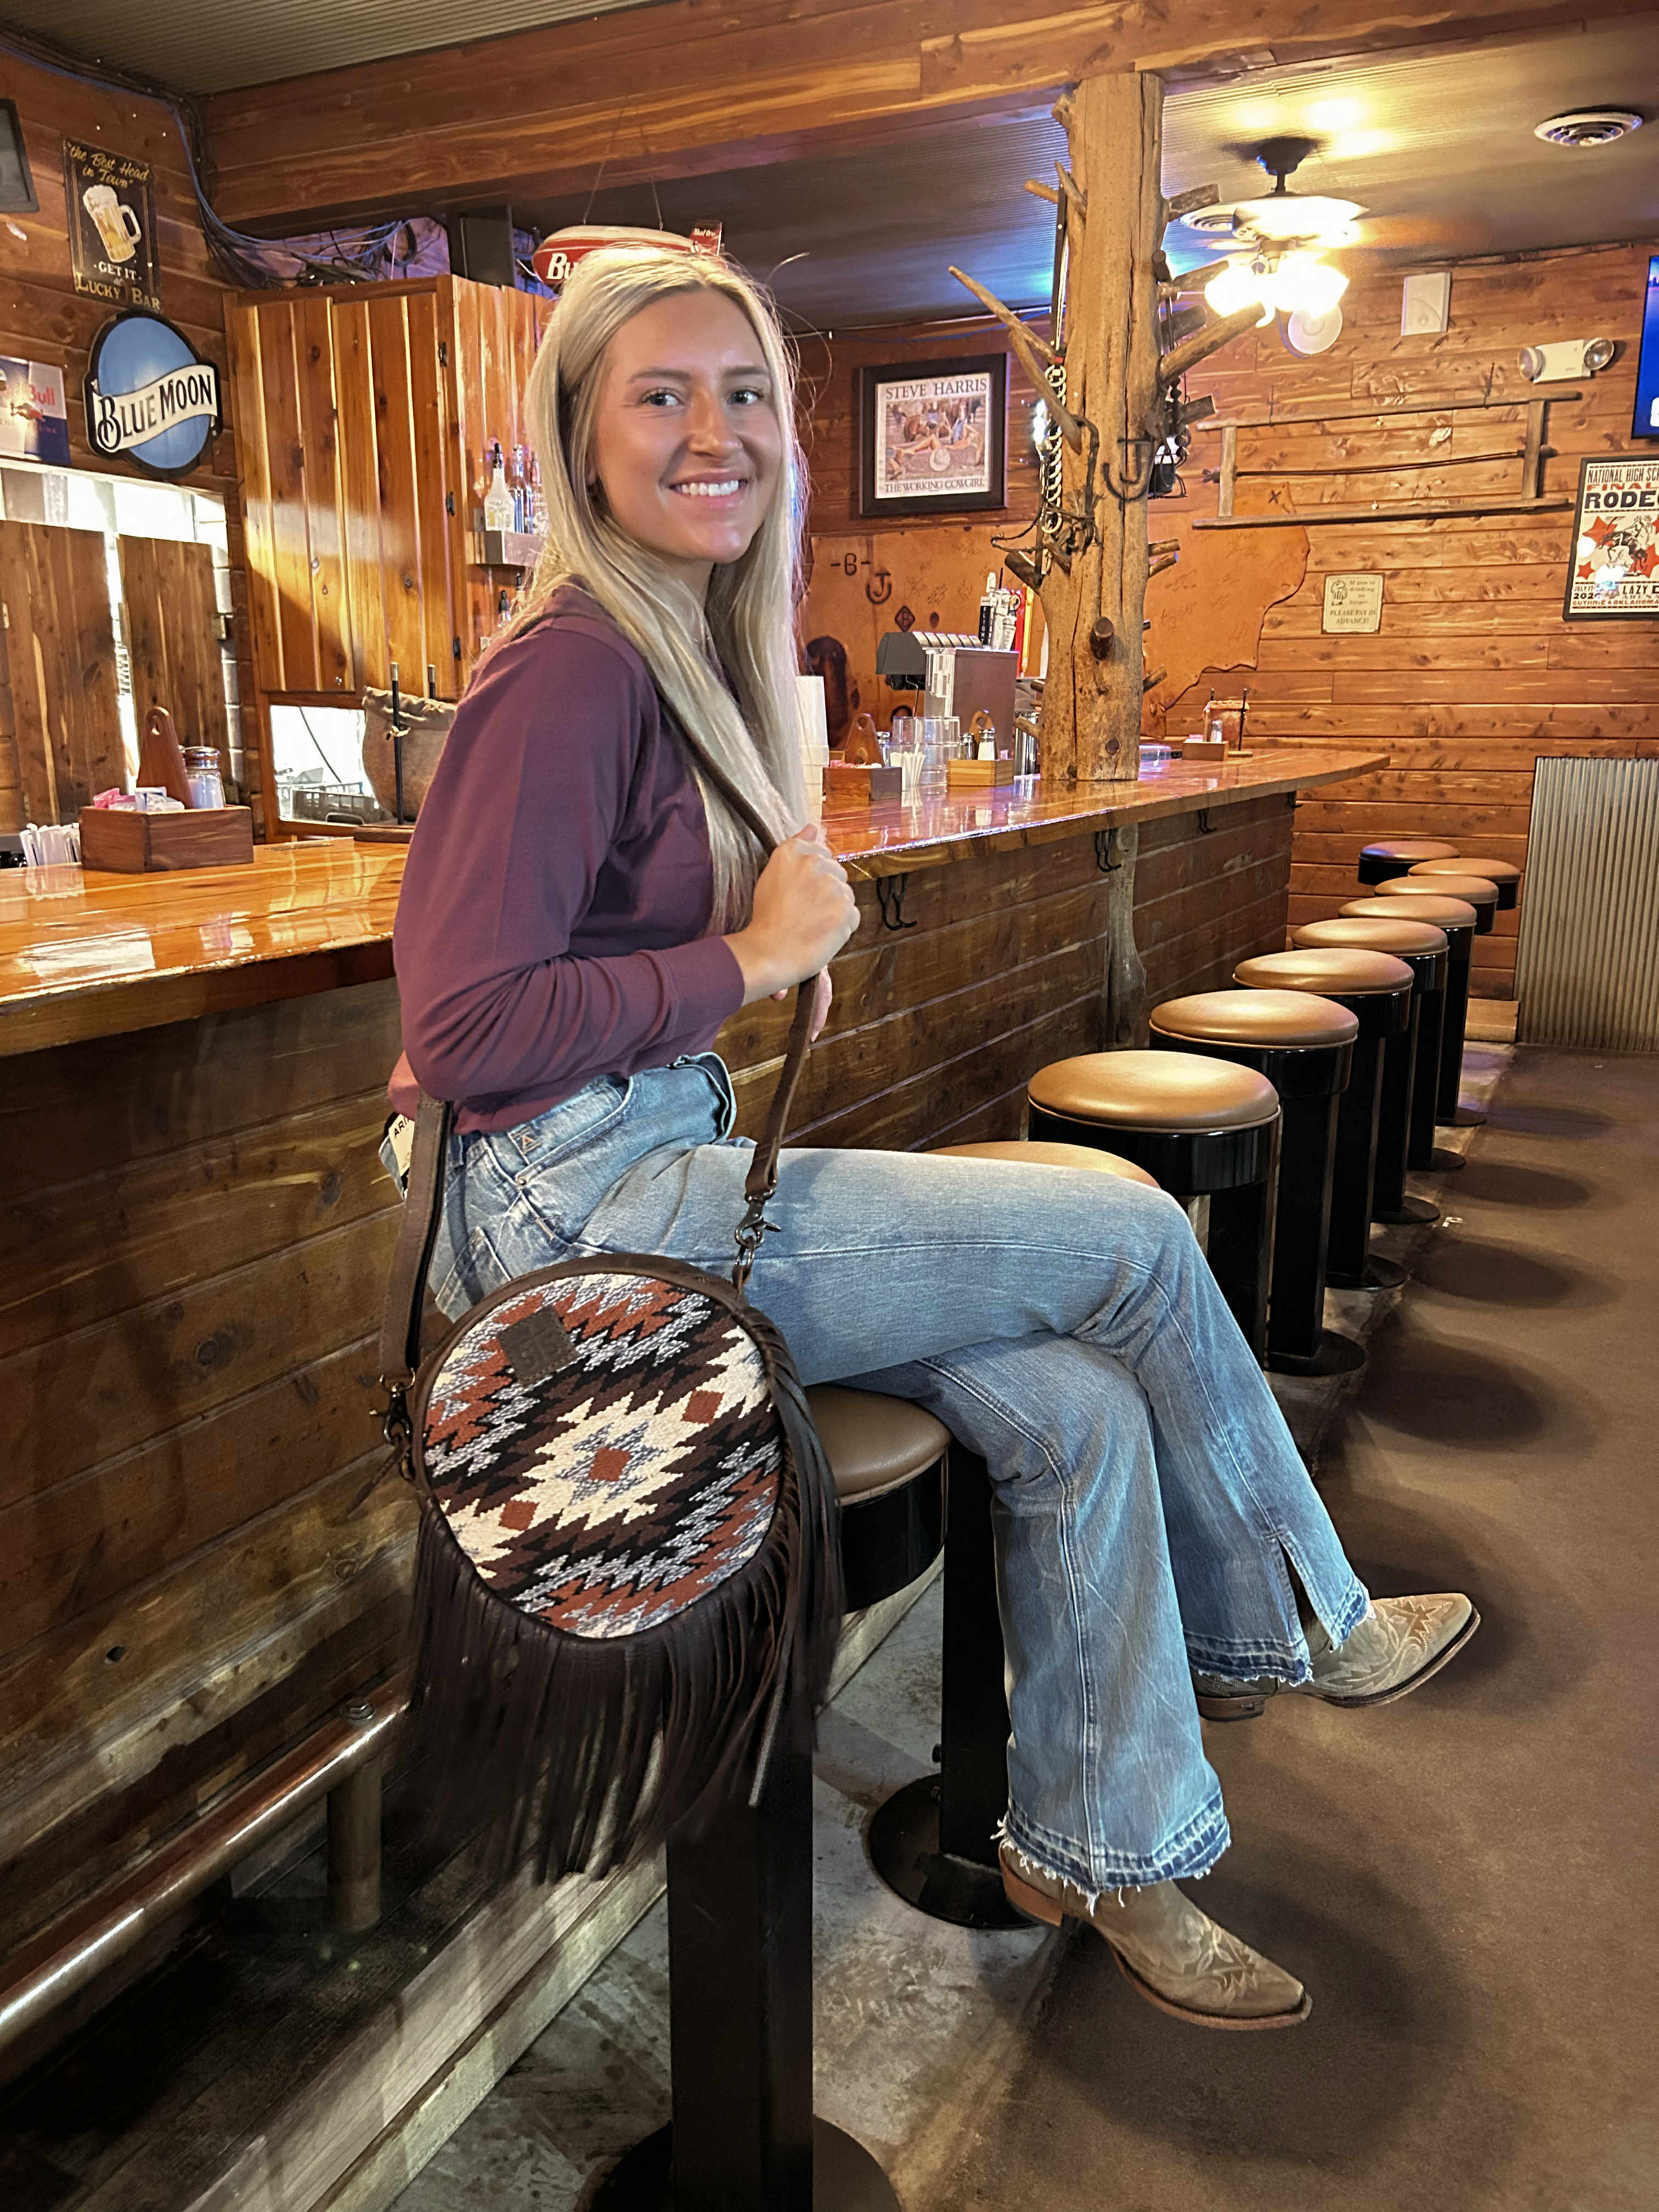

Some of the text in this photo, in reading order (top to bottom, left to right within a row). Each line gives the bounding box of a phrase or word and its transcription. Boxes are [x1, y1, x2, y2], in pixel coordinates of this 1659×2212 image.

[83, 165, 94, 177] in
[91, 153, 116, 171] Best
[119, 162, 149, 181] Head
[98, 261, 137, 281] GET IT
[546, 253, 579, 280] Bu
[886, 378, 987, 399] STEVE HARRIS
[97, 374, 212, 450] BLUE MOON
[1587, 469, 1623, 483] NATIONAL
[1626, 468, 1644, 482] HIGH
[885, 478, 985, 493] THE WORKING COWGIRL
[1584, 490, 1659, 509] RODE
[1623, 585, 1648, 595] LAZY
